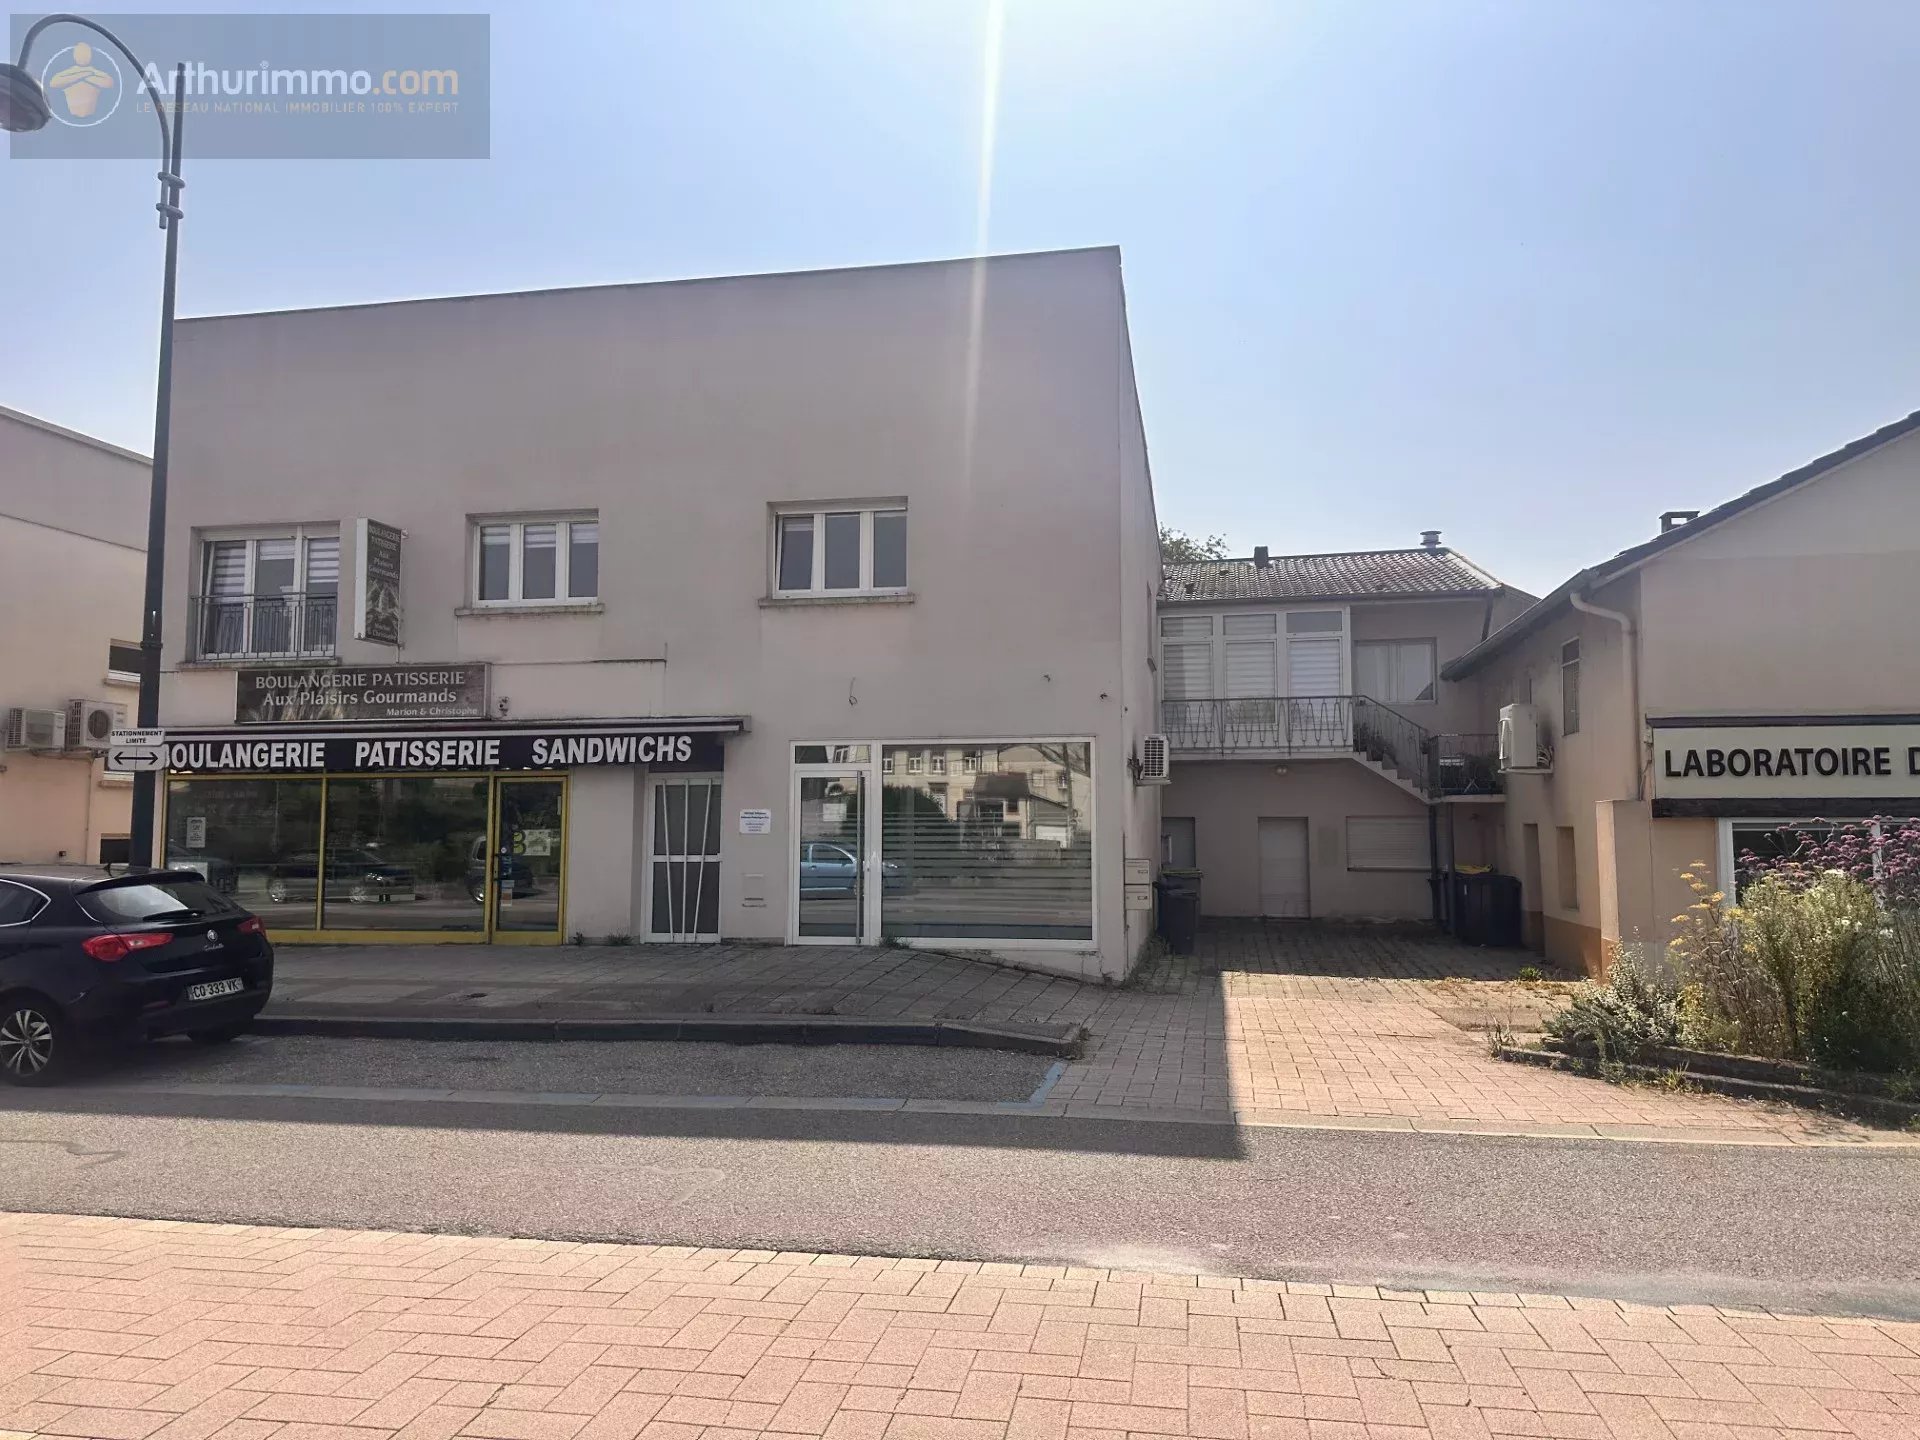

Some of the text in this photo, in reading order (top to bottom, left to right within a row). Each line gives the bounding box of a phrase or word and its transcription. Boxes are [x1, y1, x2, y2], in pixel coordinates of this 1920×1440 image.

[255, 671, 465, 689] BOULANGERIE PATISSERIE
[263, 688, 457, 706] Aux Plaisirs Gourmands
[387, 706, 478, 717] Marion & Christophe
[355, 739, 500, 767] PATISSERIE
[531, 735, 692, 766] SANDWICHS
[1665, 747, 1892, 778] LABORATOIRE
